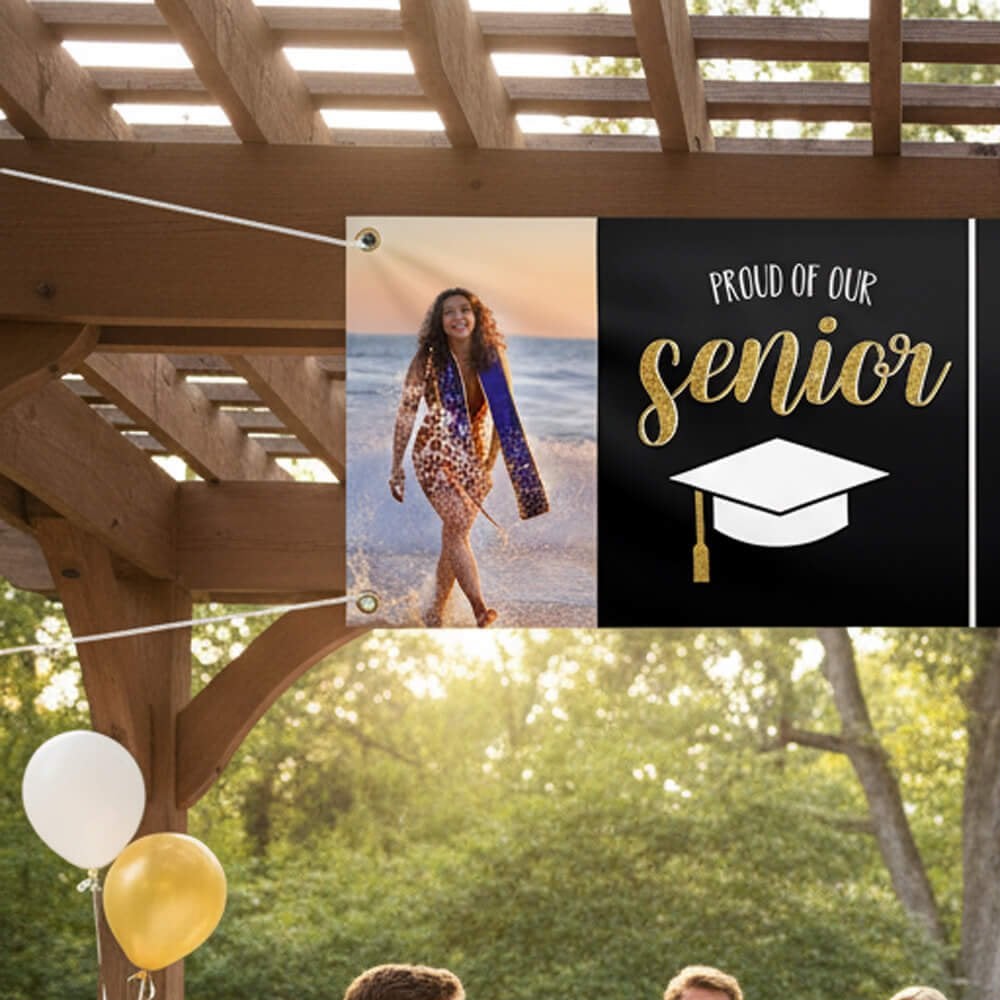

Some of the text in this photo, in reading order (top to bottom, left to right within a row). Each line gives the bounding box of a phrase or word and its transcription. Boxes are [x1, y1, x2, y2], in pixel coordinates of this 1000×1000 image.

[709, 263, 878, 306] PROUD OF OUR
[637, 315, 952, 447] senior
